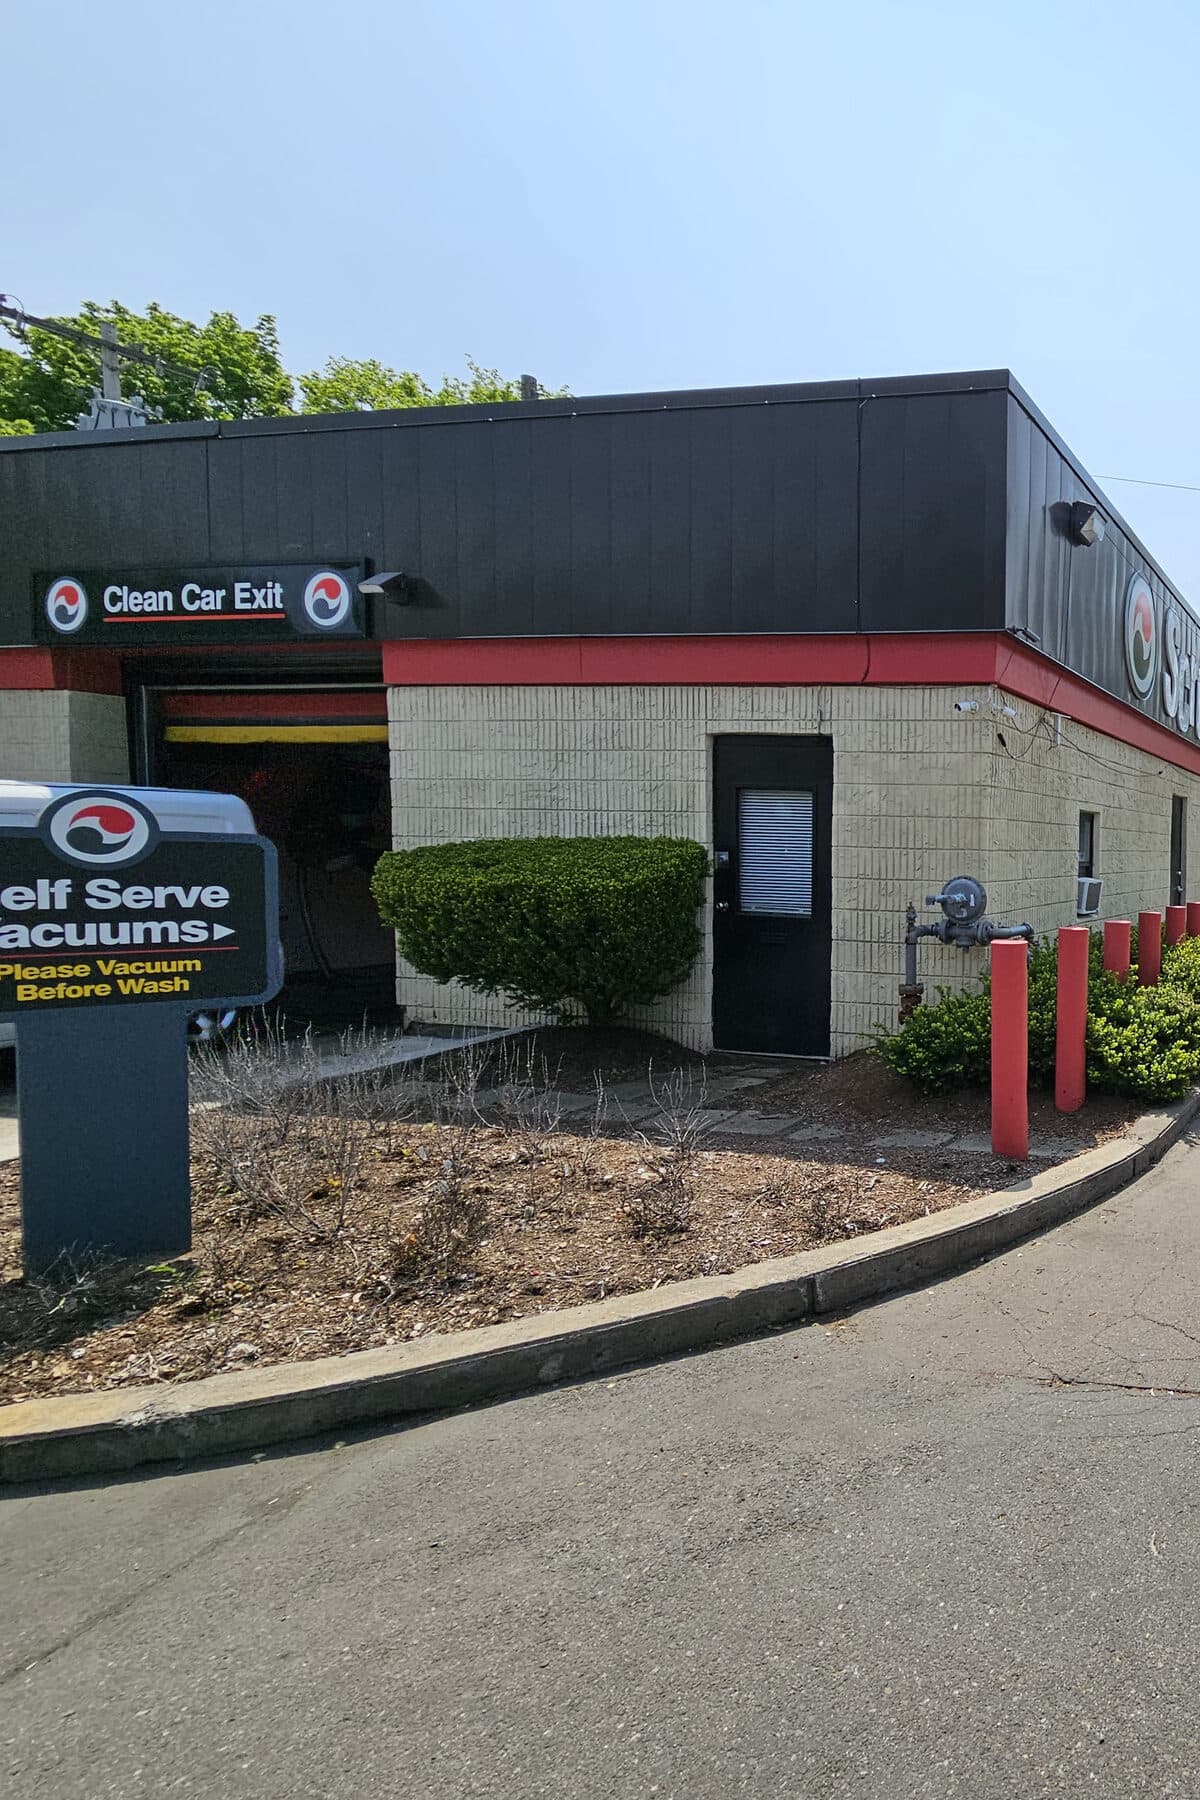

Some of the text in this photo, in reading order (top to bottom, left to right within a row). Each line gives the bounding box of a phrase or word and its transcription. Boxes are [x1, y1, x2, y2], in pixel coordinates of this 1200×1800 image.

[103, 581, 284, 613] Clean Car Exit
[0, 878, 230, 910] elf Serve
[0, 918, 209, 949] acuums
[0, 959, 201, 981] Please Vacuum
[17, 976, 190, 1001] Before Wash
